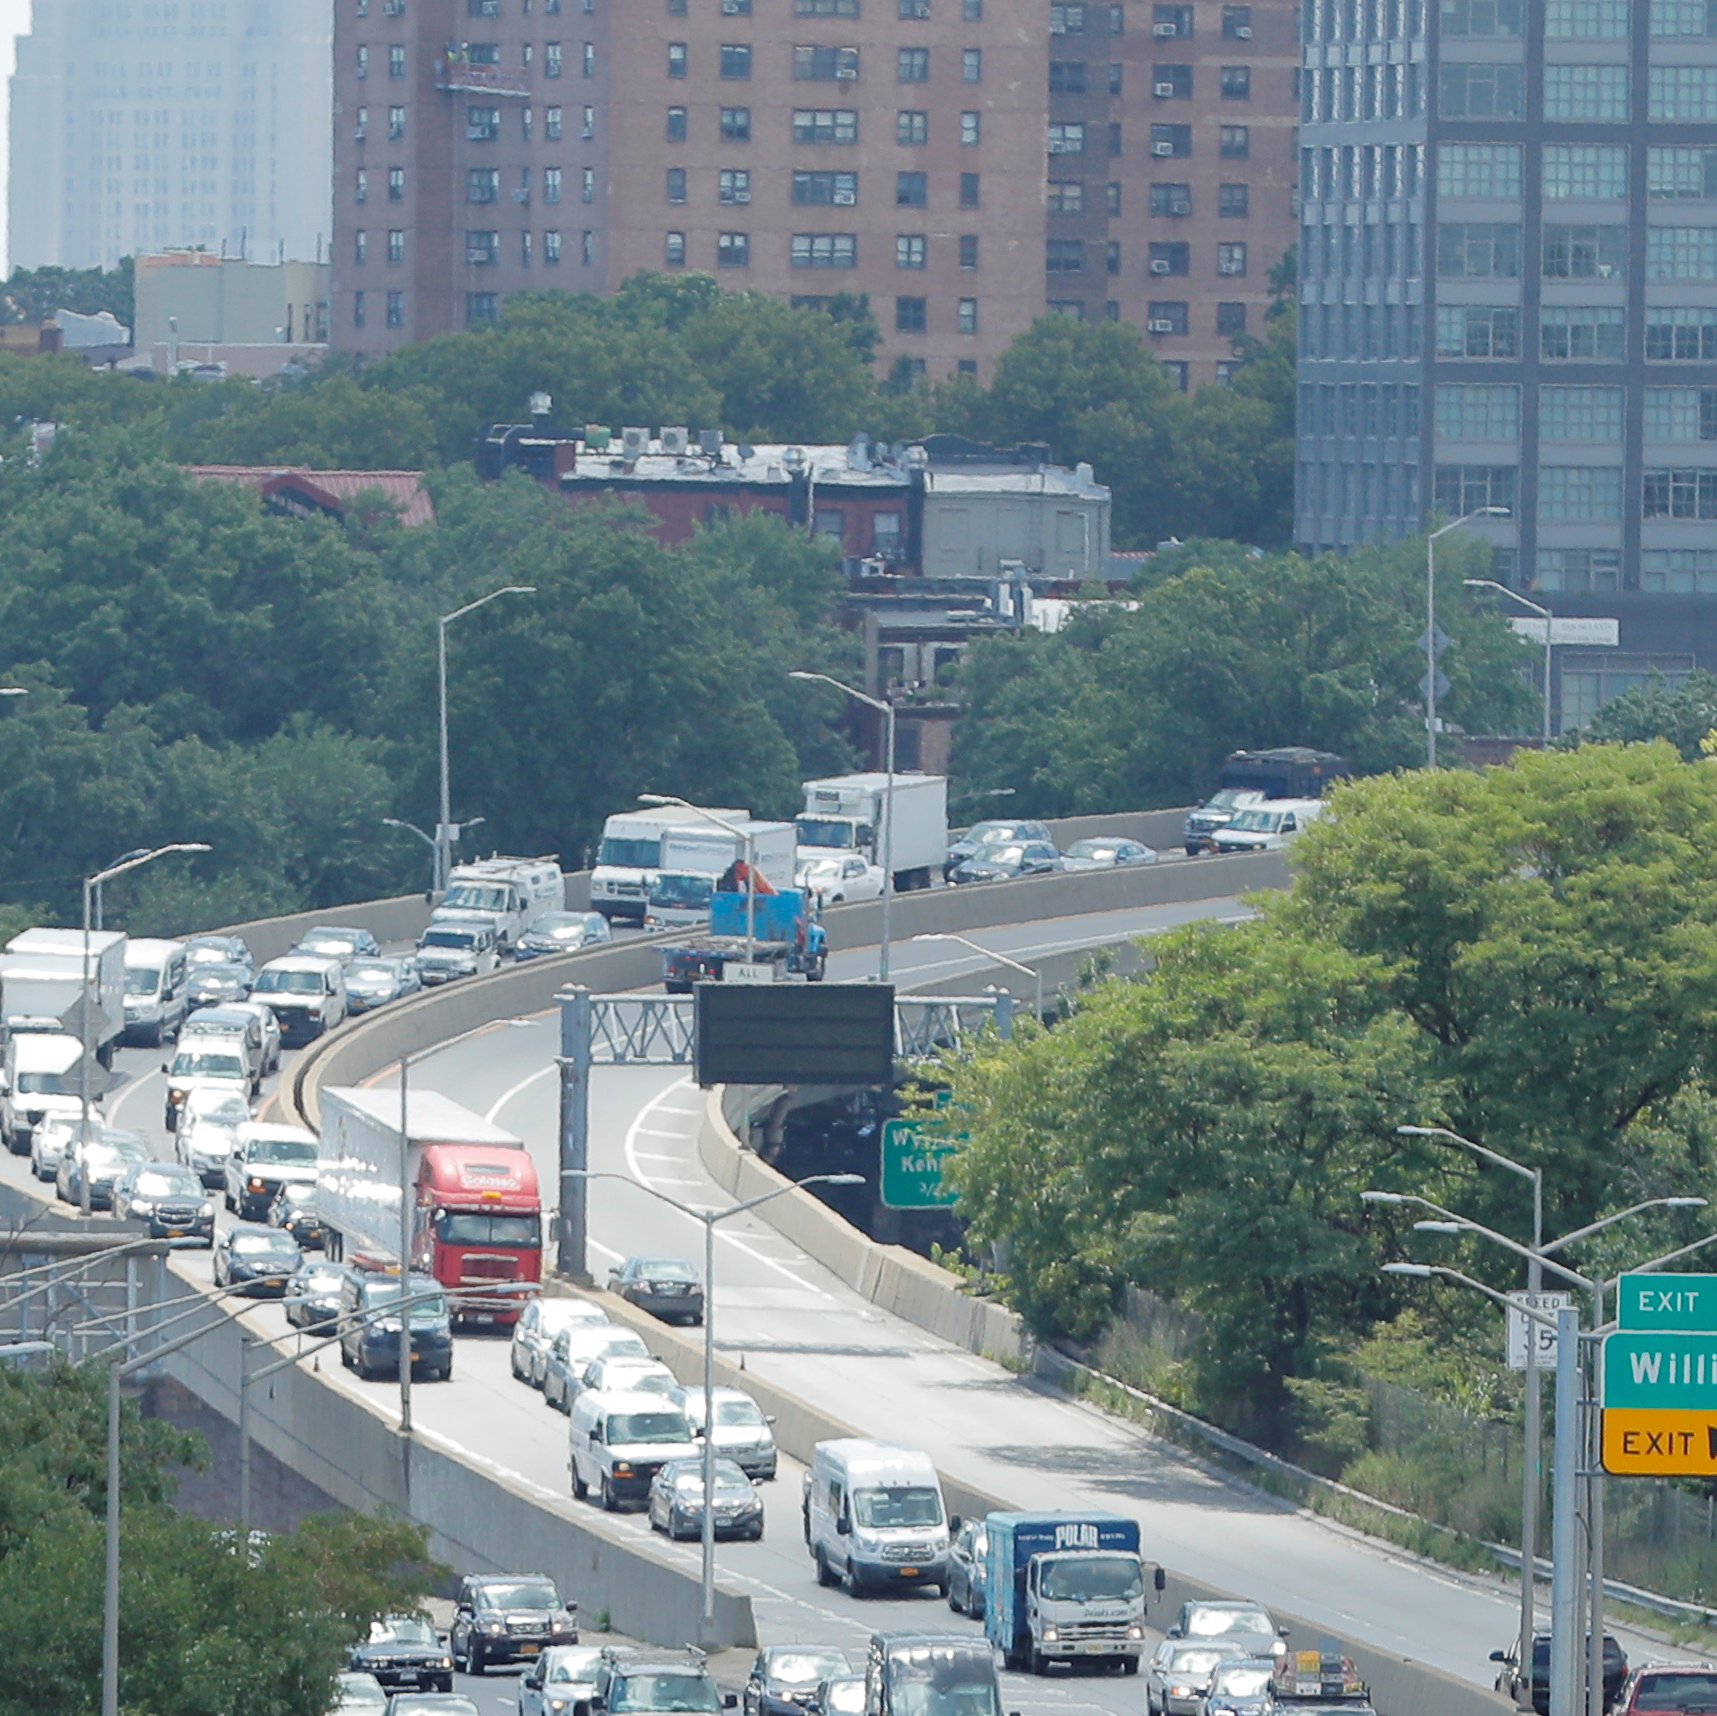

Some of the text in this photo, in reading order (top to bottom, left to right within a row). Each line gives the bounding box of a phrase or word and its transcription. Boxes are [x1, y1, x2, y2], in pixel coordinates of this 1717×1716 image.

[1638, 1291, 1699, 1312] EXIT
[1623, 1431, 1694, 1456] EXIT
[1055, 1523, 1099, 1549] POLAR
